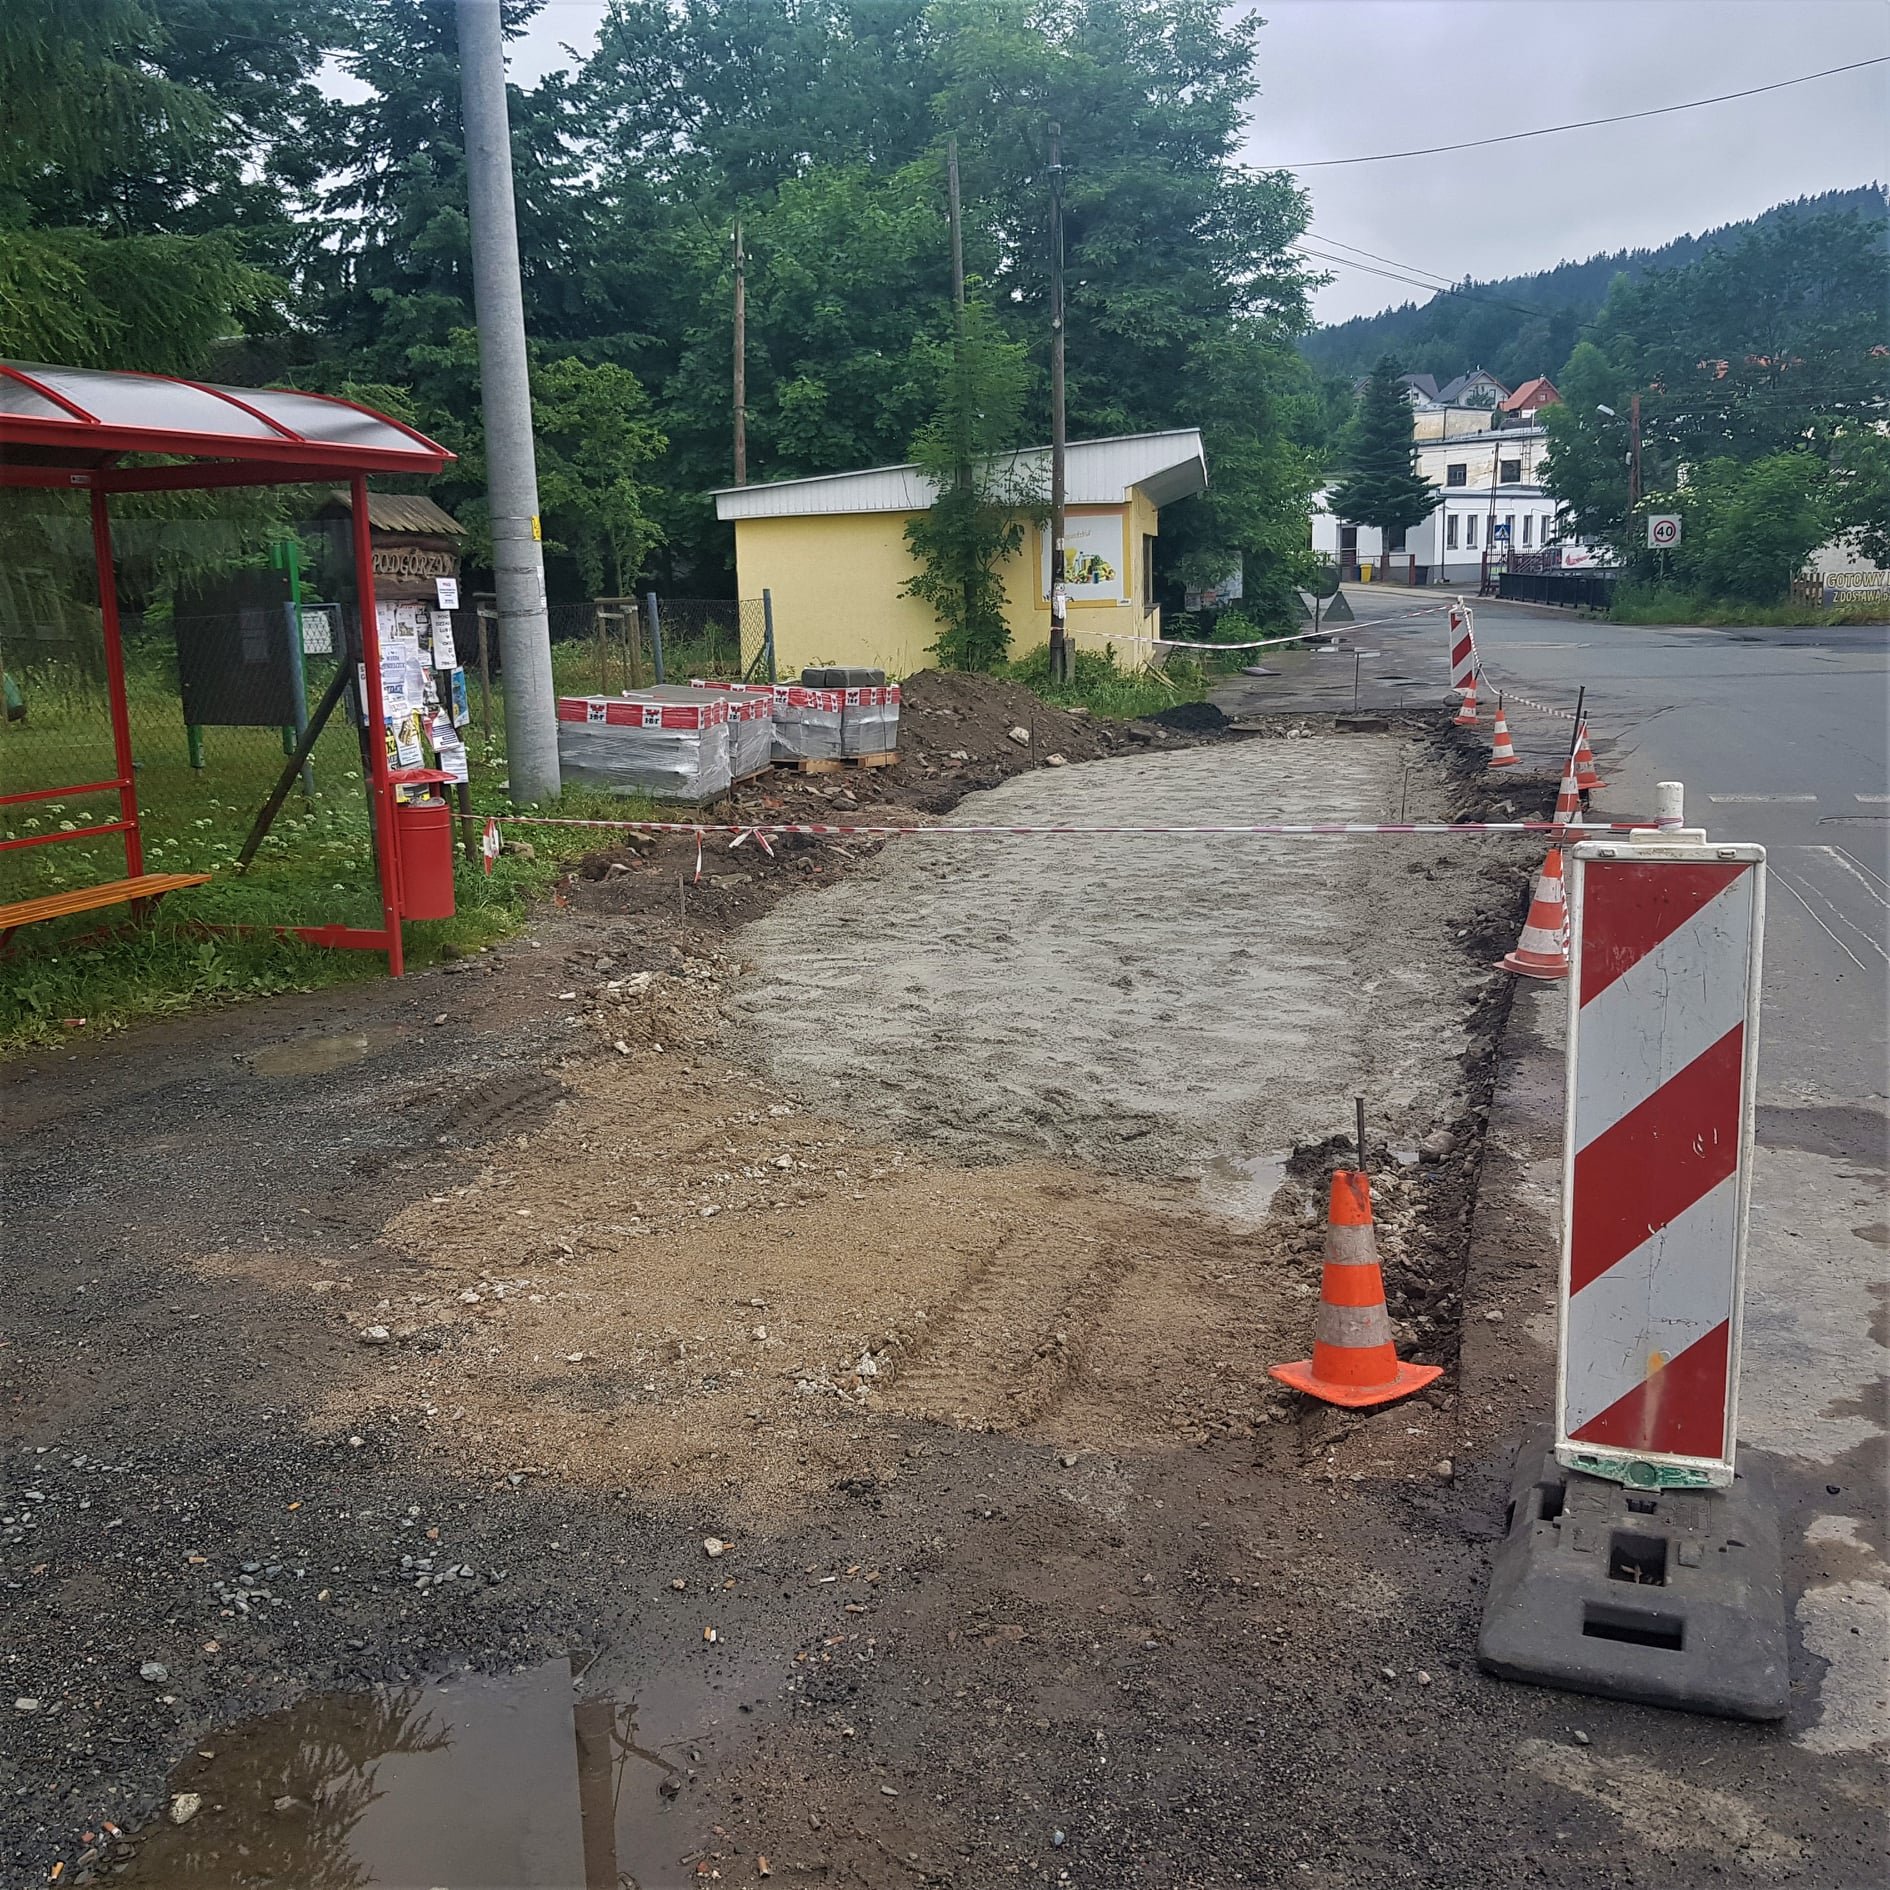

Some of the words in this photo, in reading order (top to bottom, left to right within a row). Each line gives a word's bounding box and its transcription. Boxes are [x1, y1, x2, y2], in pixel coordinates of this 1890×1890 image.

[1657, 526, 1673, 537] 40
[1826, 572, 1885, 588] GOTOWY
[1832, 591, 1838, 603] Z
